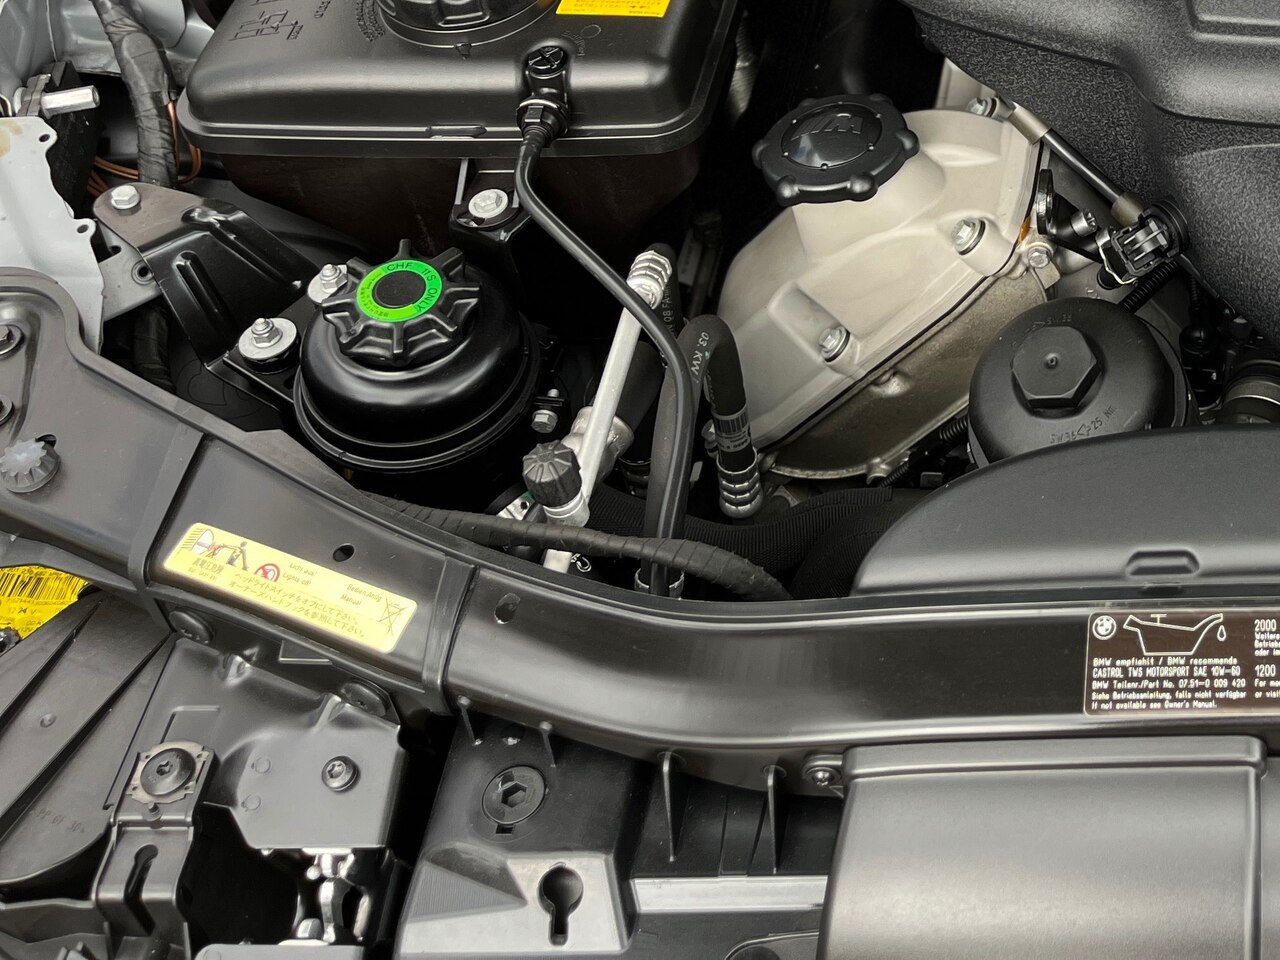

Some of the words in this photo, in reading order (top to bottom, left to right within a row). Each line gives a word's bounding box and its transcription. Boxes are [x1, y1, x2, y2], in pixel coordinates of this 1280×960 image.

[387, 262, 413, 271] CHF
[416, 287, 438, 312] ONLY
[1254, 619, 1276, 631] 2000
[1255, 632, 1280, 640] Weitere
[1255, 648, 1269, 656] oder
[1093, 657, 1112, 667] BMW
[1116, 657, 1154, 667] empfiehlt
[1167, 656, 1185, 666] BMW
[1190, 656, 1238, 665] recommends
[1092, 668, 1124, 678] CASTROL
[1128, 667, 1143, 677] TWS
[1146, 666, 1189, 677] MOTORSPORT
[1193, 666, 1207, 677] SAE
[1211, 666, 1241, 677] 10W-60
[1255, 664, 1276, 677] 1200
[1092, 680, 1109, 690] BMW
[1163, 679, 1175, 689] No.
[1213, 678, 1228, 688] 009
[1231, 678, 1246, 688] 420
[1255, 678, 1266, 687] For
[1092, 692, 1109, 700] Siehe
[1175, 690, 1191, 699] falls
[1195, 690, 1211, 699] nicht
[1215, 690, 1247, 700] verfügbar
[1092, 701, 1098, 710] If
[1101, 701, 1112, 710] not
[1116, 701, 1146, 709] available
[1164, 700, 1189, 709] Owner's
